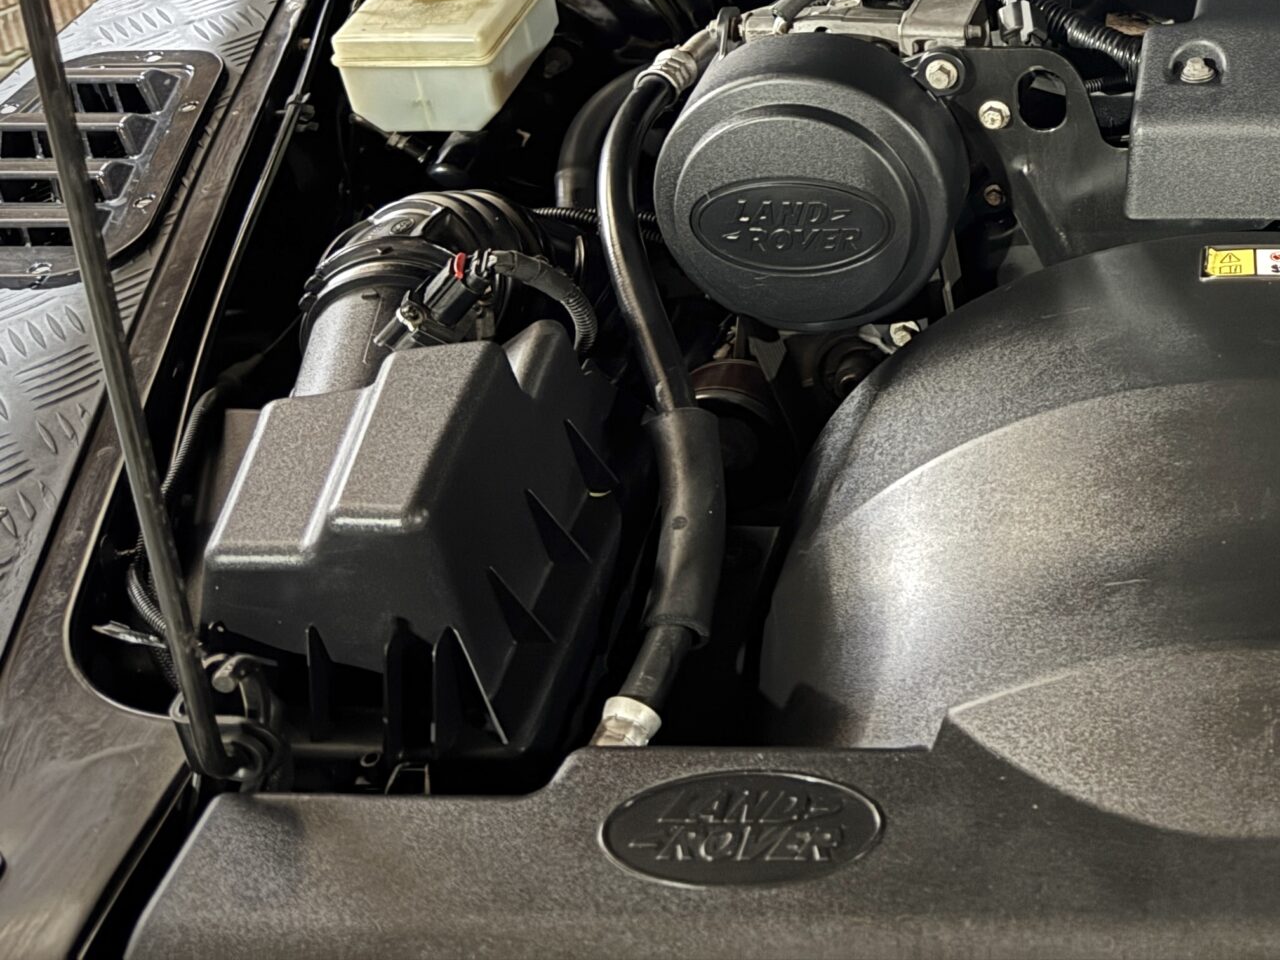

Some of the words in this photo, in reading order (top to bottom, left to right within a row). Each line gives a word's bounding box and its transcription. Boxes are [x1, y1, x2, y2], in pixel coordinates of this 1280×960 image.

[736, 199, 829, 226] LAND
[747, 227, 861, 253] ROVER
[655, 788, 802, 824] LAND
[655, 825, 846, 862] ROVER
